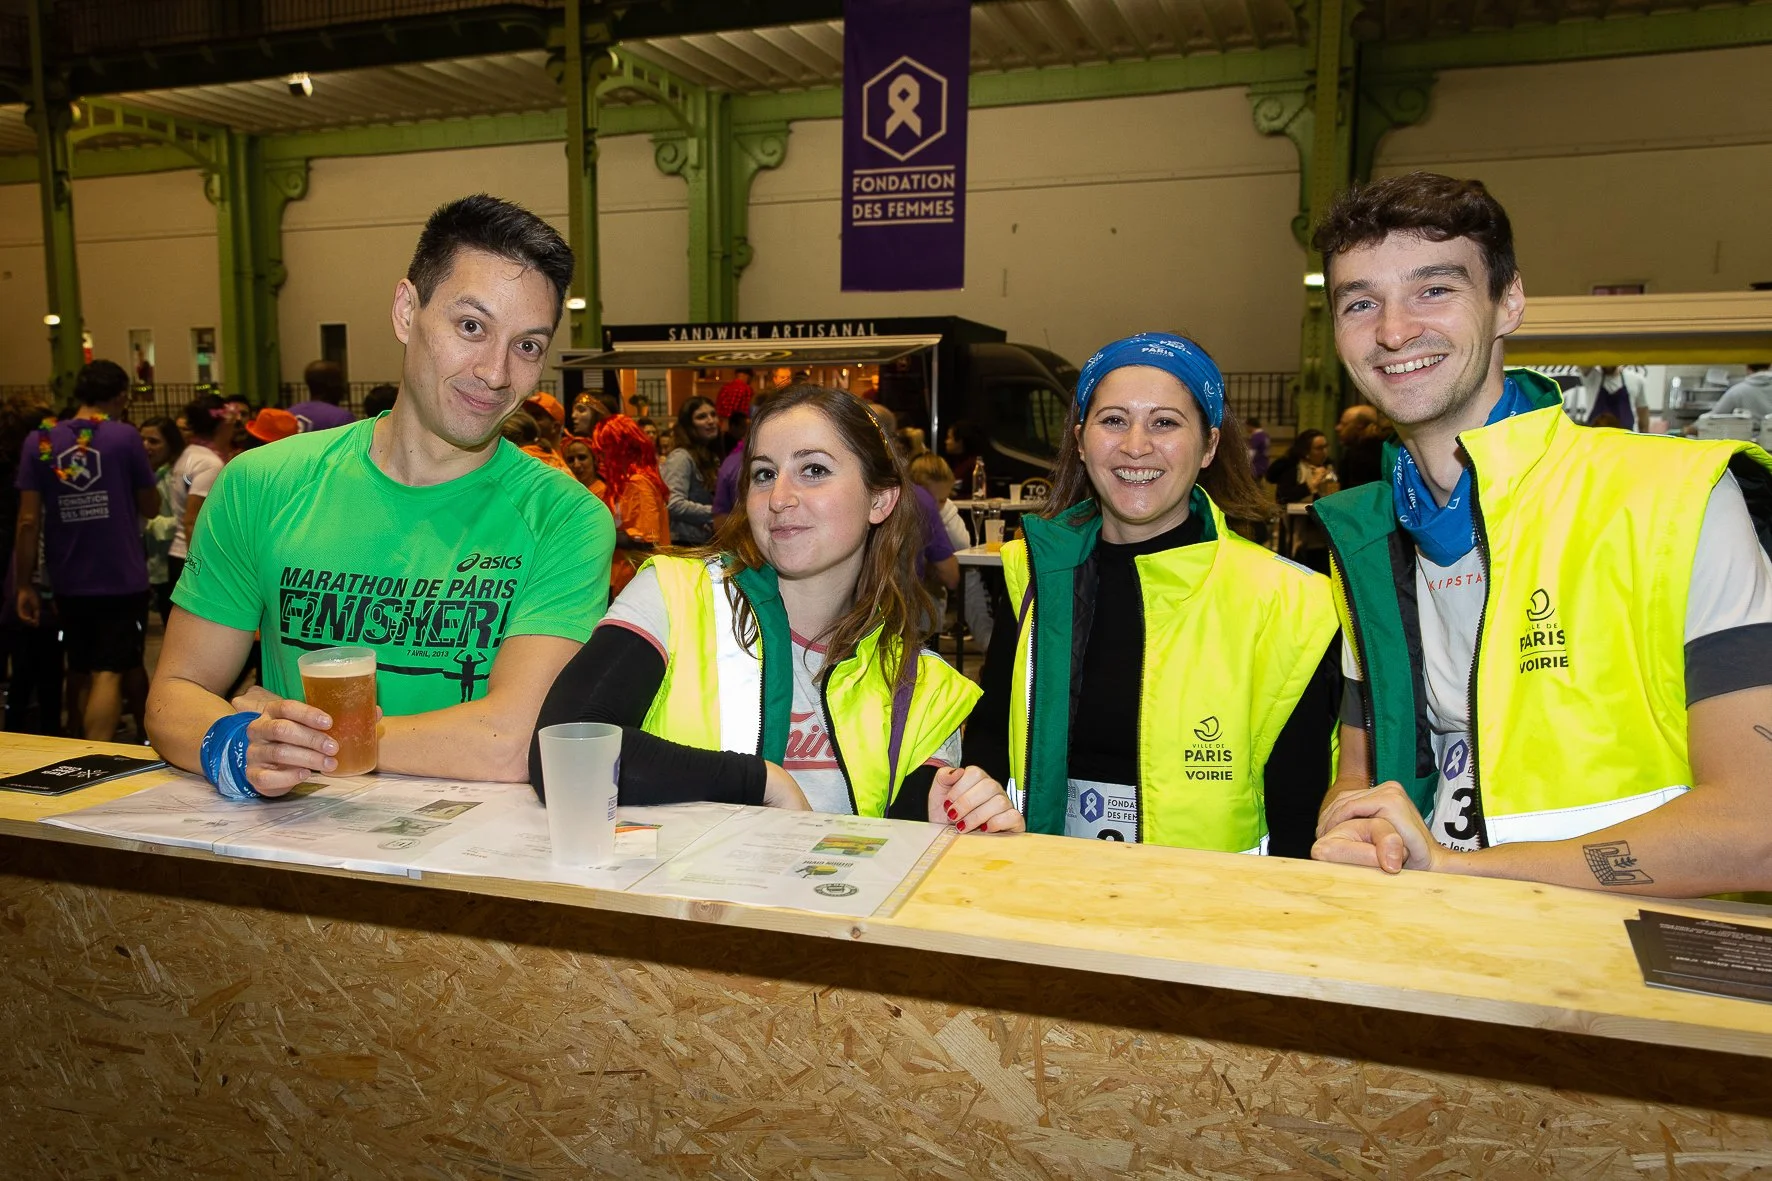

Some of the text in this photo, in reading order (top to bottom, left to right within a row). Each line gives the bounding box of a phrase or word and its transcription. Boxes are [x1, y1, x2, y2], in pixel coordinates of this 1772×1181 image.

[852, 173, 955, 192] FONDATION
[852, 200, 954, 219] DES FEMMES
[669, 323, 878, 341] SANDWICH ARTISANAL
[479, 554, 522, 570] asics
[280, 567, 518, 600] MARATHON DE PARIS
[1429, 572, 1482, 591] KIPSTA
[279, 588, 514, 649] FINISHER!
[1519, 629, 1566, 652] PARIS
[411, 650, 430, 659] AVRIL,
[432, 650, 449, 658] 2013
[1519, 655, 1569, 674] VOIRIE
[1184, 749, 1233, 762] PARIS
[1185, 770, 1233, 781] VOIRIE
[1107, 811, 1121, 820] DES
[1443, 787, 1478, 841] 3
